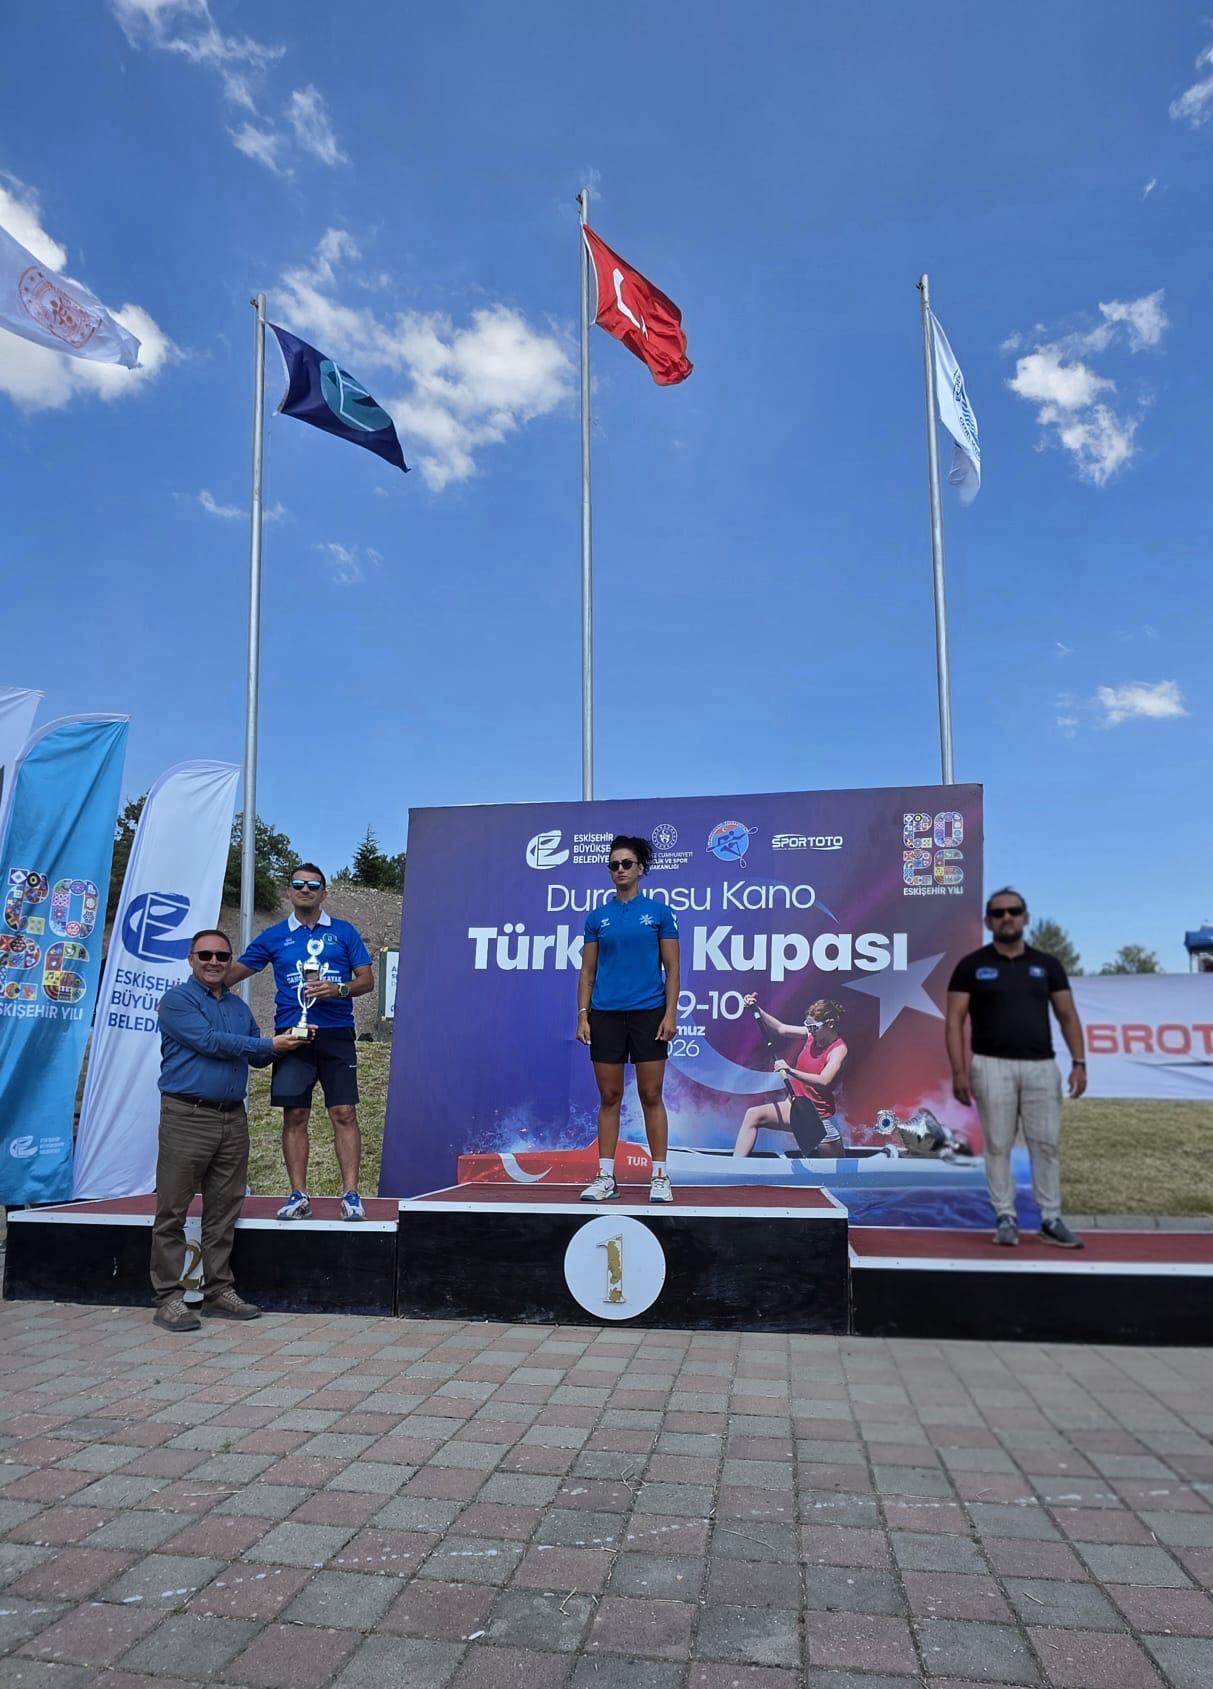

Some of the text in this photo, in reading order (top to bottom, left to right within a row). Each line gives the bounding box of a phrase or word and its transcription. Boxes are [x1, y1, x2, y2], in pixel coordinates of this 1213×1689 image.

[573, 832, 614, 842] ESKİŞEHİR
[573, 843, 612, 853] BÜYÜKŞE
[573, 853, 610, 864] BELEDİYE
[903, 884, 964, 896] ESKİŞEHİR YILI
[547, 881, 816, 913] Durnsu Kano
[468, 922, 908, 982] Türk Kupası
[115, 968, 181, 993] ESKİŞEH
[61, 1007, 85, 1021] YILI
[626, 1155, 648, 1167] TUR
[596, 1233, 626, 1304] 1
